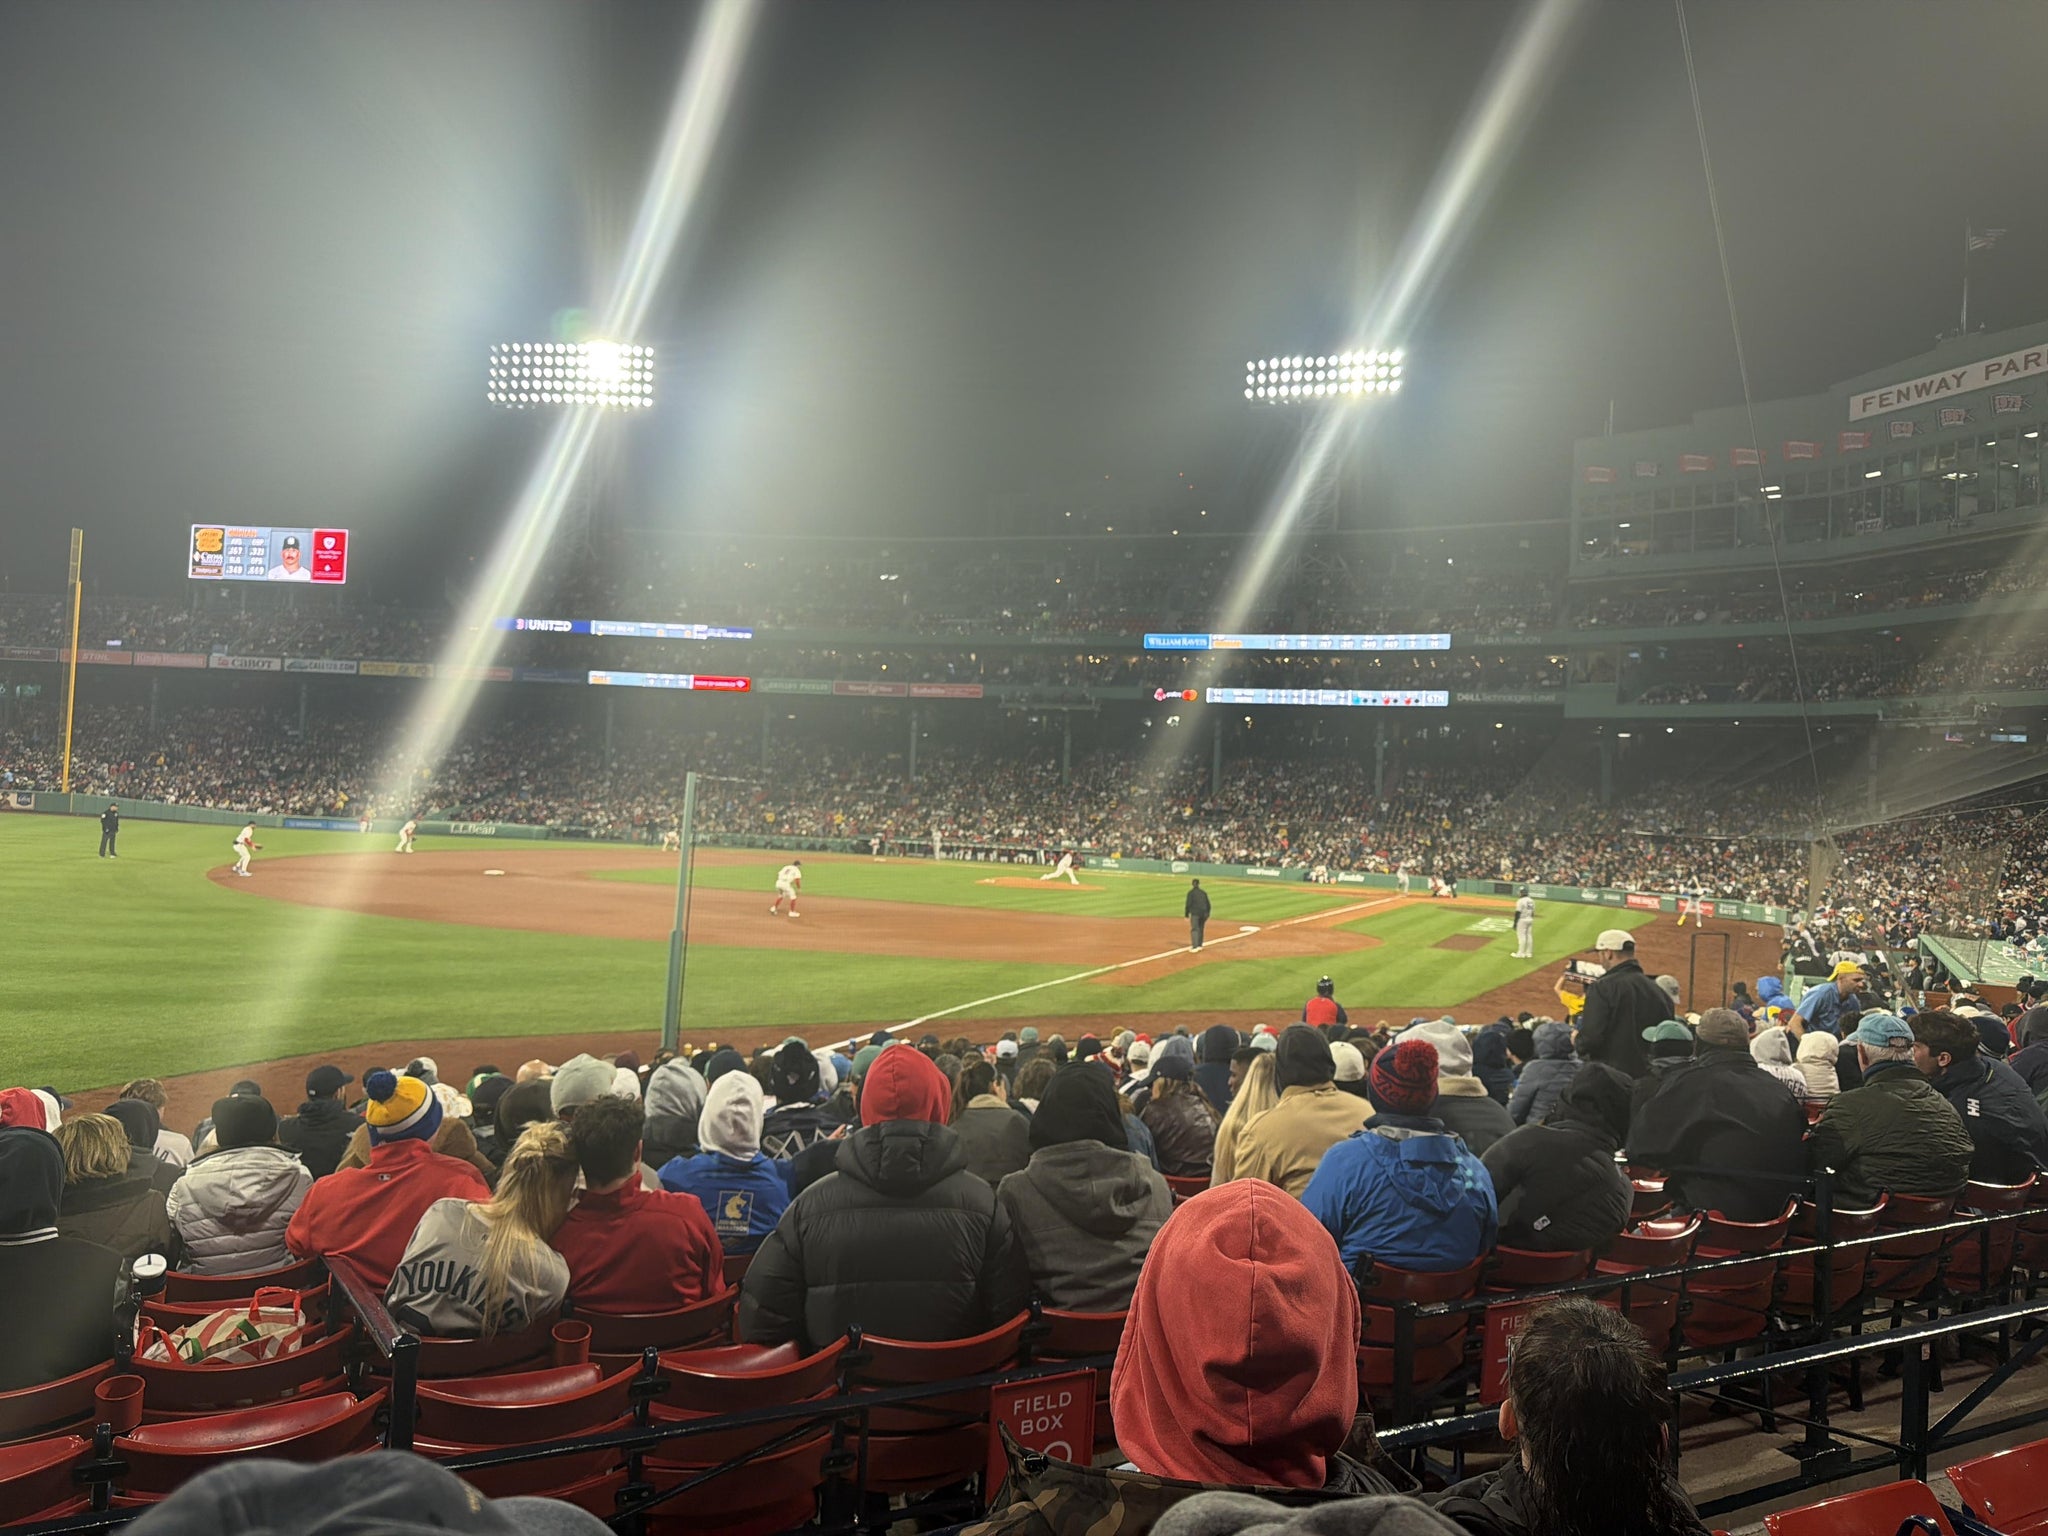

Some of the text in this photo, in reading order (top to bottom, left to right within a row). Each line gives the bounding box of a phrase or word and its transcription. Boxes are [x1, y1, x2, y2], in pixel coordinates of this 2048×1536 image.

[1861, 349, 2048, 413] FENWAY PAR
[528, 619, 572, 632] UNITED
[1149, 637, 1181, 647] WILLIAM
[1500, 1314, 1528, 1331] FIE
[1013, 1391, 1072, 1416] FIELD
[1020, 1412, 1064, 1436] BOX
